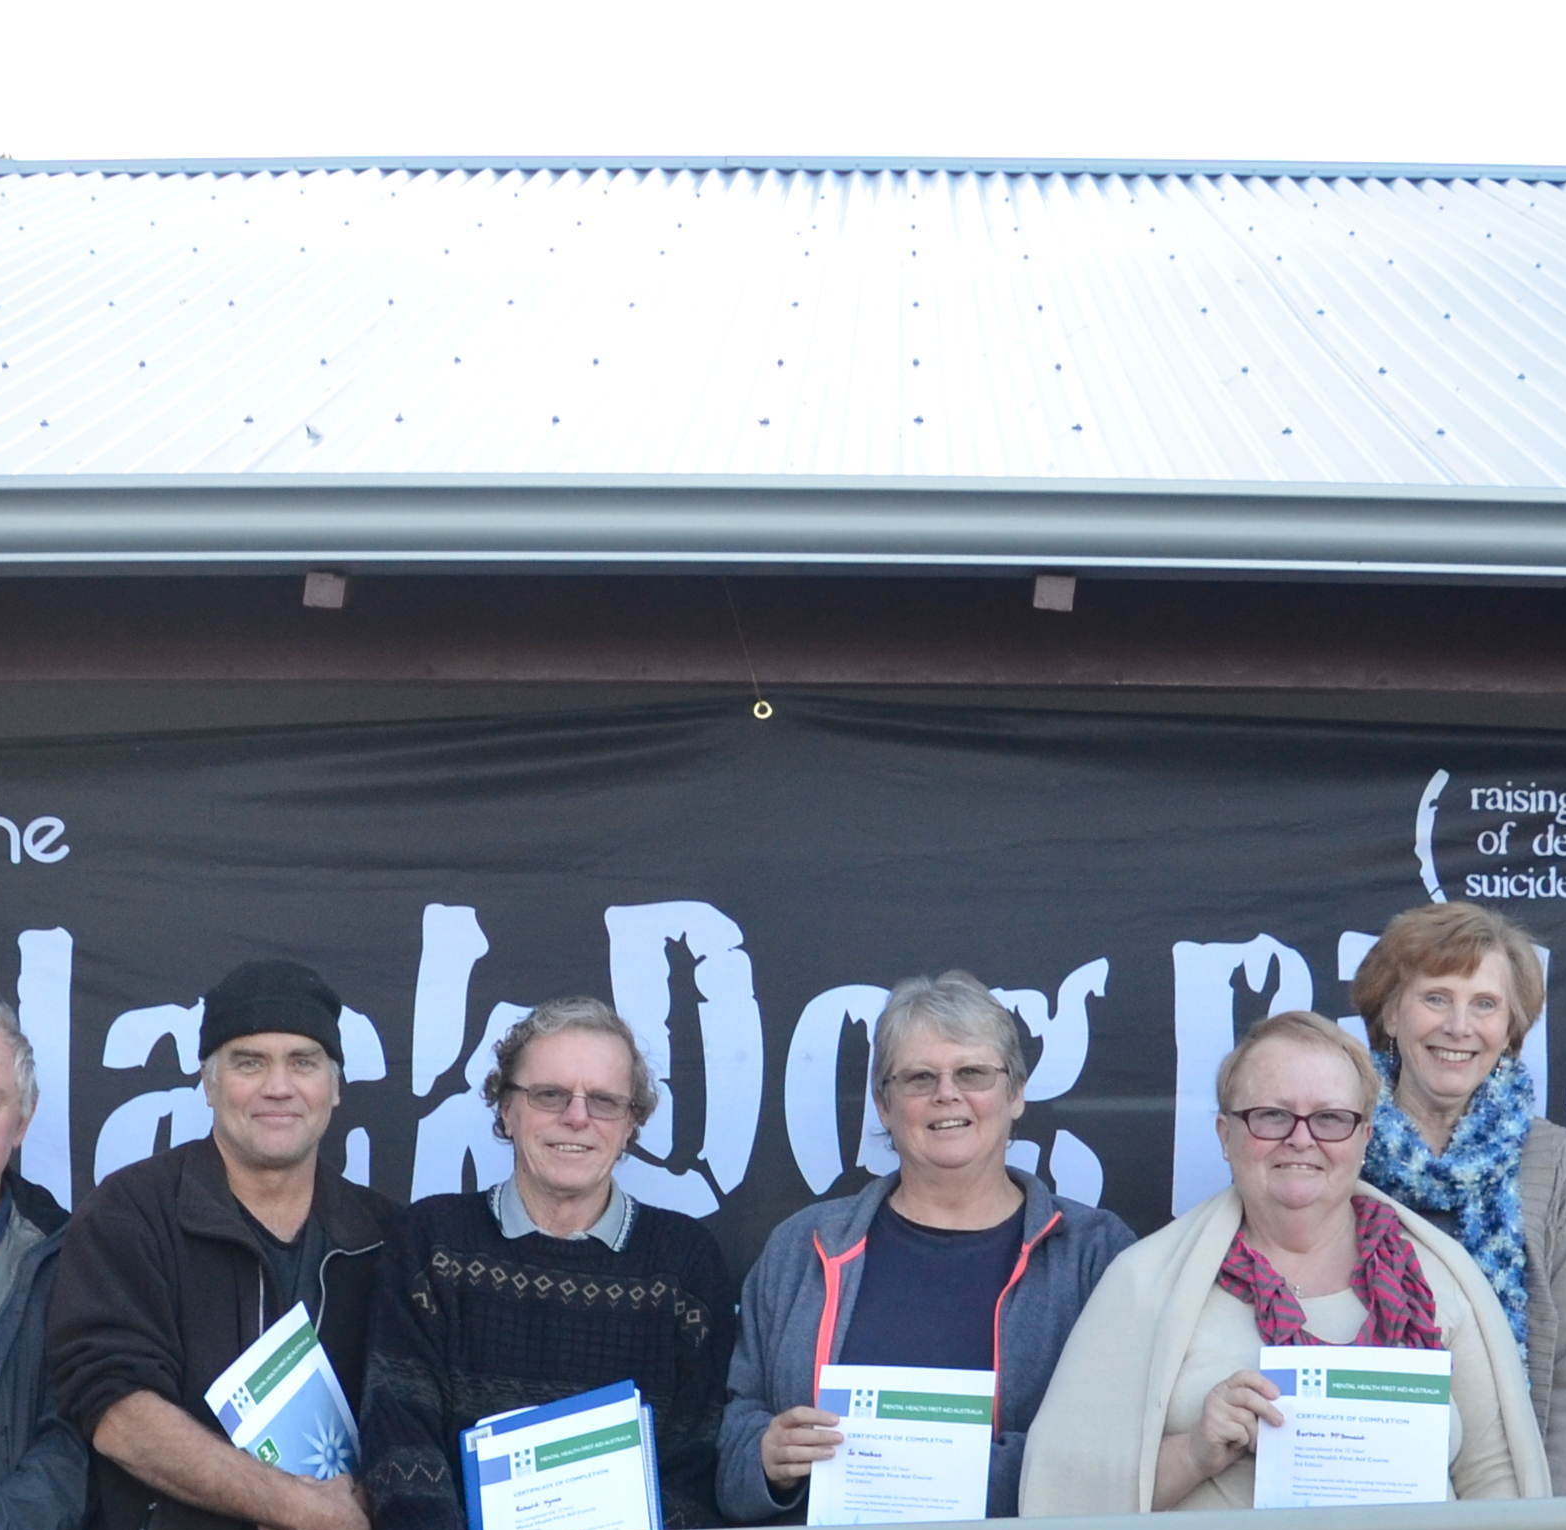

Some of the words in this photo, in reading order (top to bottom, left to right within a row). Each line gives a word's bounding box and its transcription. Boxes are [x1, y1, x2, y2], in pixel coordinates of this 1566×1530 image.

[1476, 822, 1516, 856] of
[1297, 1413, 1343, 1421] CERTIFICATE
[1359, 1416, 1409, 1424] COMPLETION
[539, 1452, 559, 1462] MENTAL
[561, 1447, 580, 1457] HEALTH
[581, 1443, 593, 1451] FIRST
[594, 1440, 604, 1448] AID
[605, 1433, 631, 1445] AUSTRALIA
[848, 1432, 891, 1440] CERTIFICATE
[514, 1482, 552, 1496] CERTIFICATE
[565, 1468, 608, 1483] COMPLETION
